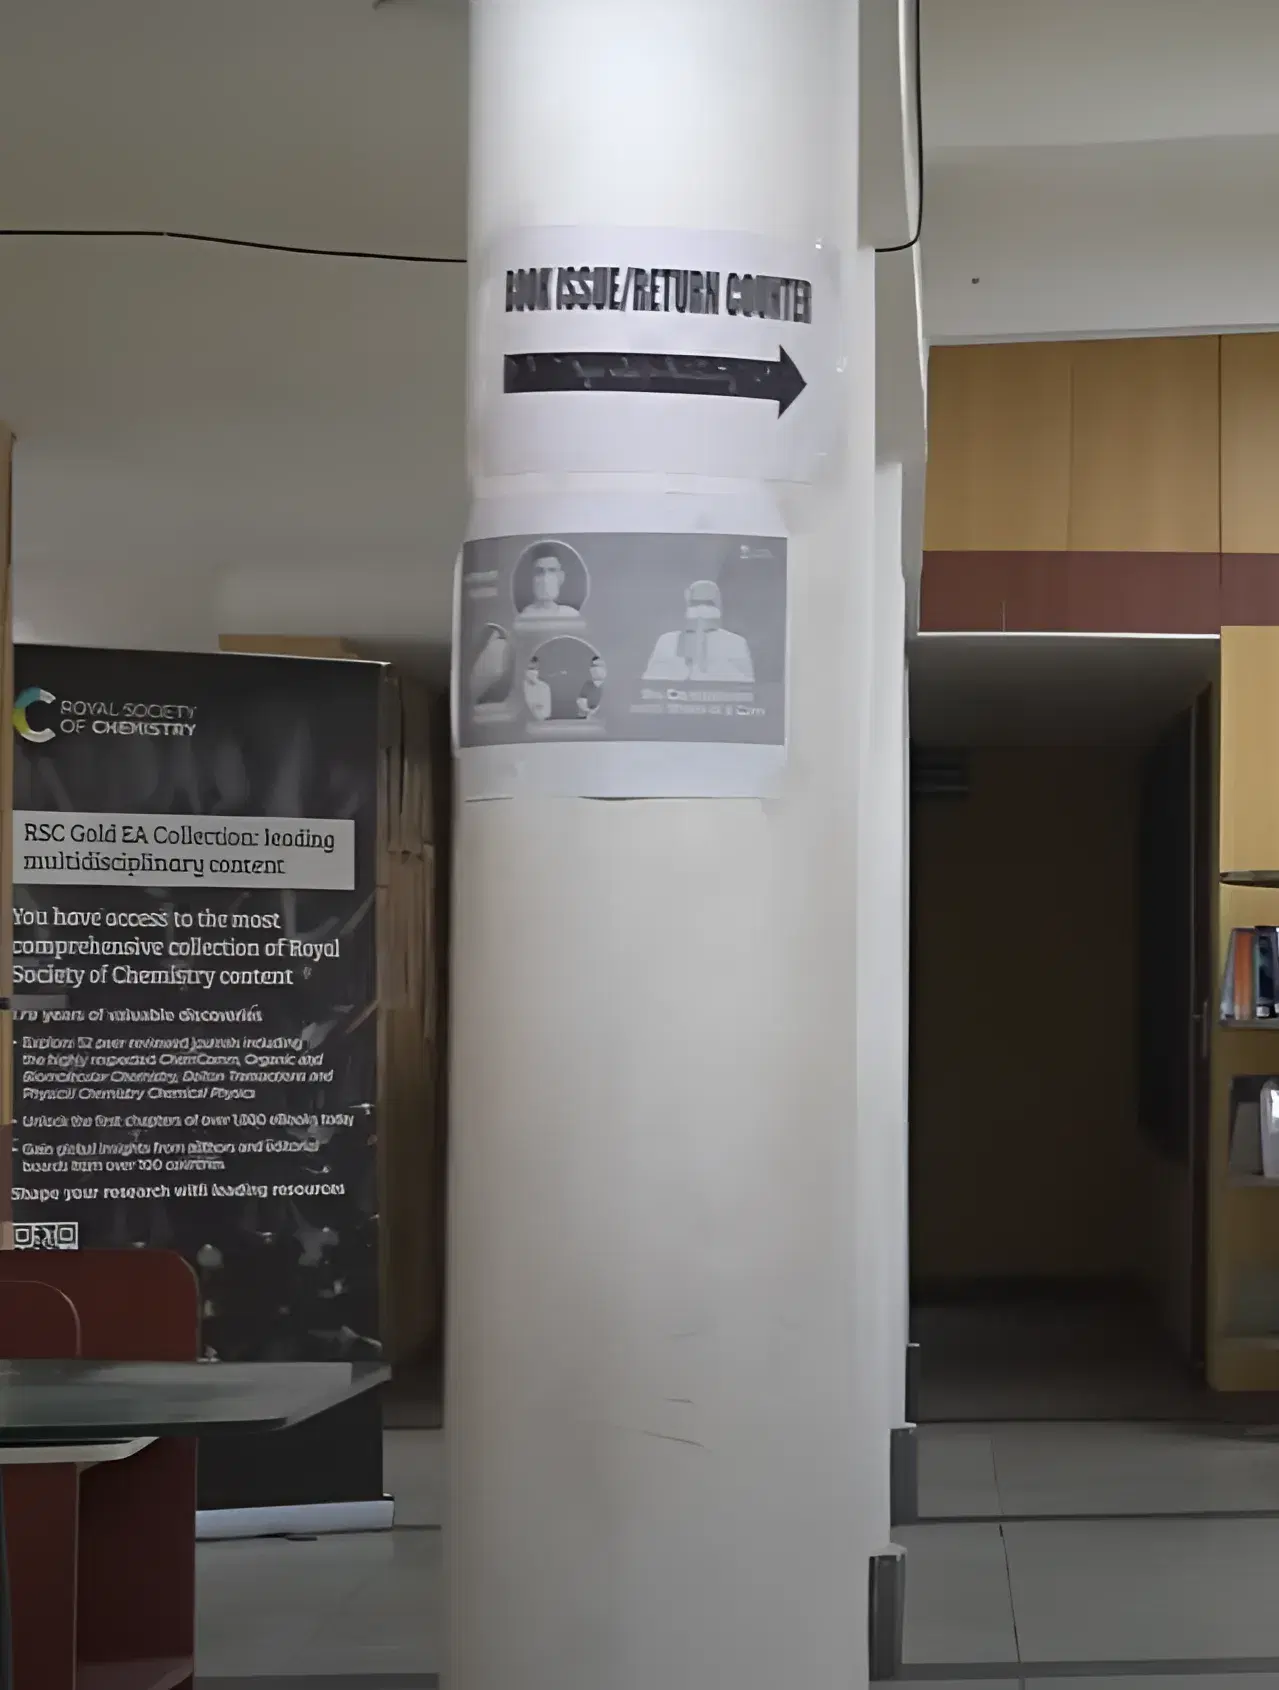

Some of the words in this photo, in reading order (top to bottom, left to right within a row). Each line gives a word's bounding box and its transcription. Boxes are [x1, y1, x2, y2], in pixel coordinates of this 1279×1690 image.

[60, 700, 118, 716] ROYAL
[122, 702, 197, 719] SOCIETY
[60, 719, 86, 734] OF
[92, 720, 196, 736] CHEMISTRY
[24, 823, 65, 843] RSC
[70, 824, 116, 844] Gold
[154, 826, 259, 847] Collection:
[264, 828, 335, 854] leading
[23, 851, 204, 877] multidisciplinary
[209, 858, 286, 875] content
[12, 909, 48, 927] You
[52, 906, 101, 927] have
[105, 912, 168, 927] access
[173, 911, 193, 928] to
[197, 908, 228, 928] the
[231, 911, 282, 929] most
[12, 936, 164, 960] comprehensive
[168, 937, 260, 958] collection
[264, 938, 290, 958] of
[289, 939, 341, 962] Royal
[12, 964, 85, 989] Society
[89, 965, 109, 984] of
[111, 965, 216, 989] Chemistry
[219, 968, 294, 986] content
